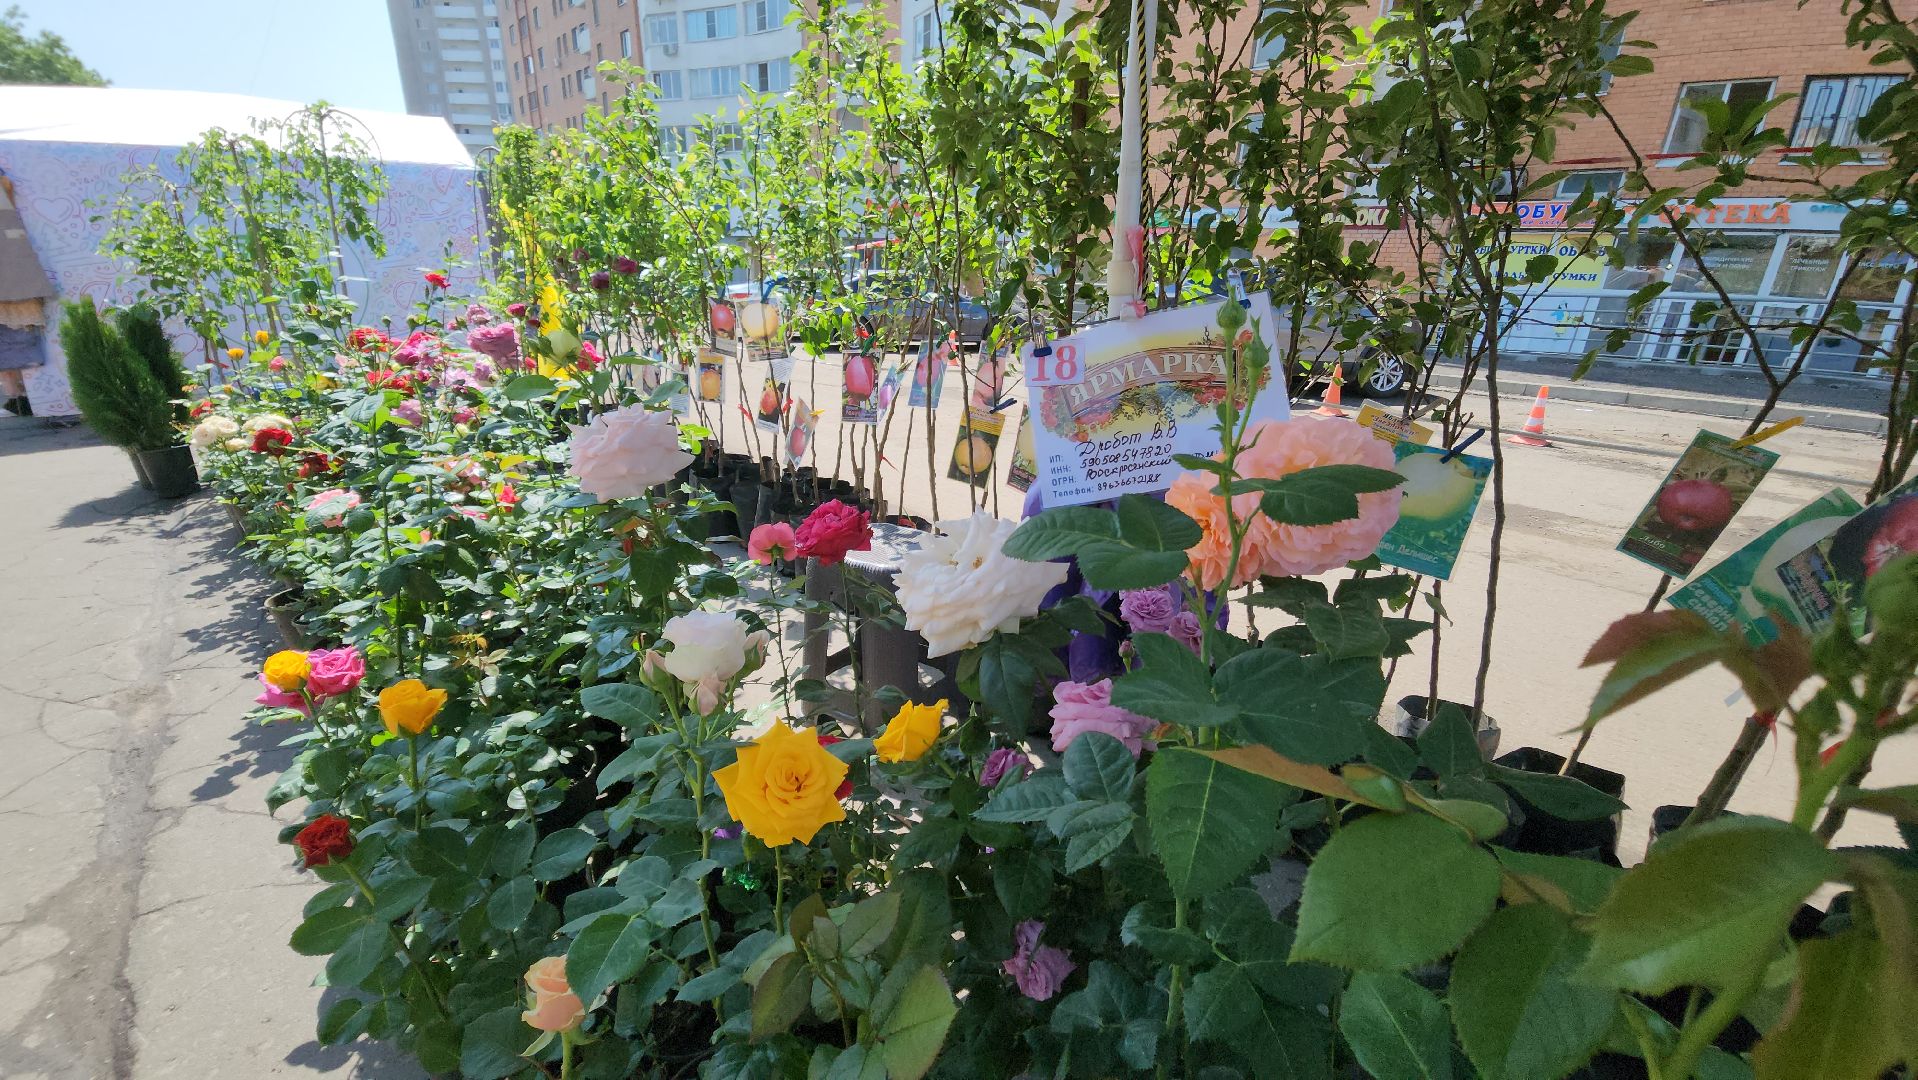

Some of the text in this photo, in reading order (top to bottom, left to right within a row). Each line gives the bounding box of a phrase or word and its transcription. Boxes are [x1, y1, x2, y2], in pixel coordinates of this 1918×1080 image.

[1510, 245, 1547, 255] УРТКИ
[1552, 272, 1598, 281] СУМКИ
[1031, 345, 1077, 382] 18
[1069, 352, 1228, 407] ЯРМАРКА
[1049, 455, 1063, 464] ИП:
[1050, 466, 1072, 475] ИНН:
[1051, 476, 1077, 487] ОГРН:
[1053, 486, 1095, 499] Телефон:
[1686, 581, 1735, 622] Северн
